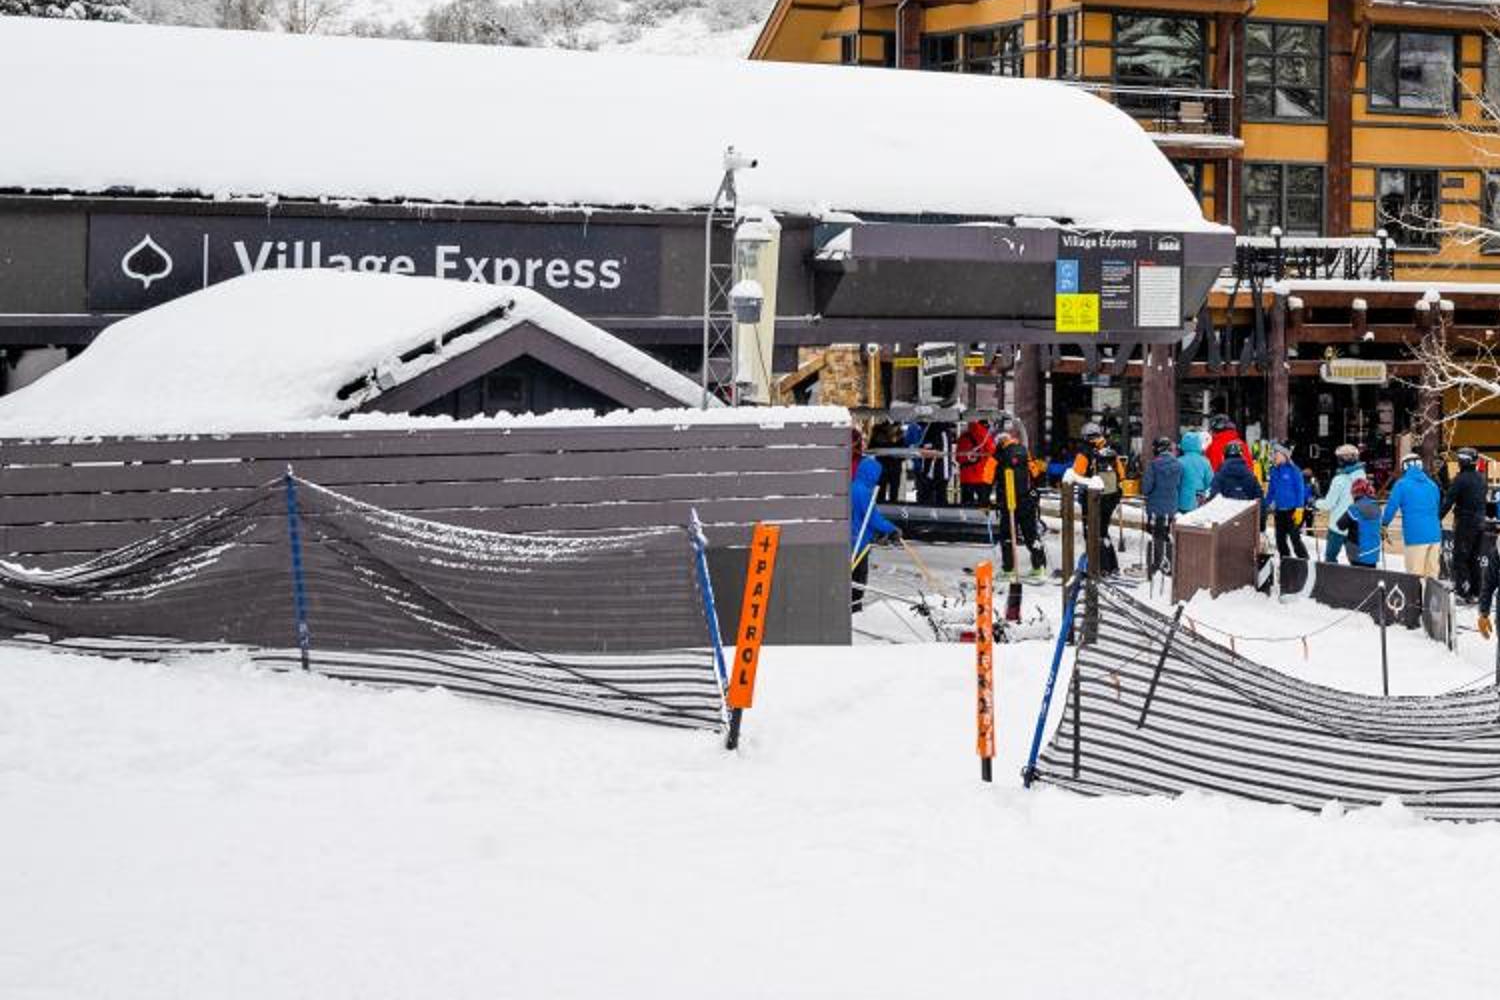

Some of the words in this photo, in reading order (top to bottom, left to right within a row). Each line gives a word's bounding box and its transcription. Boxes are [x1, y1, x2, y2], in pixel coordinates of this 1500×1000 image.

[1061, 236, 1097, 249] Village
[1099, 236, 1137, 250] Express
[435, 245, 622, 290] Express
[739, 559, 768, 686] PATROL
